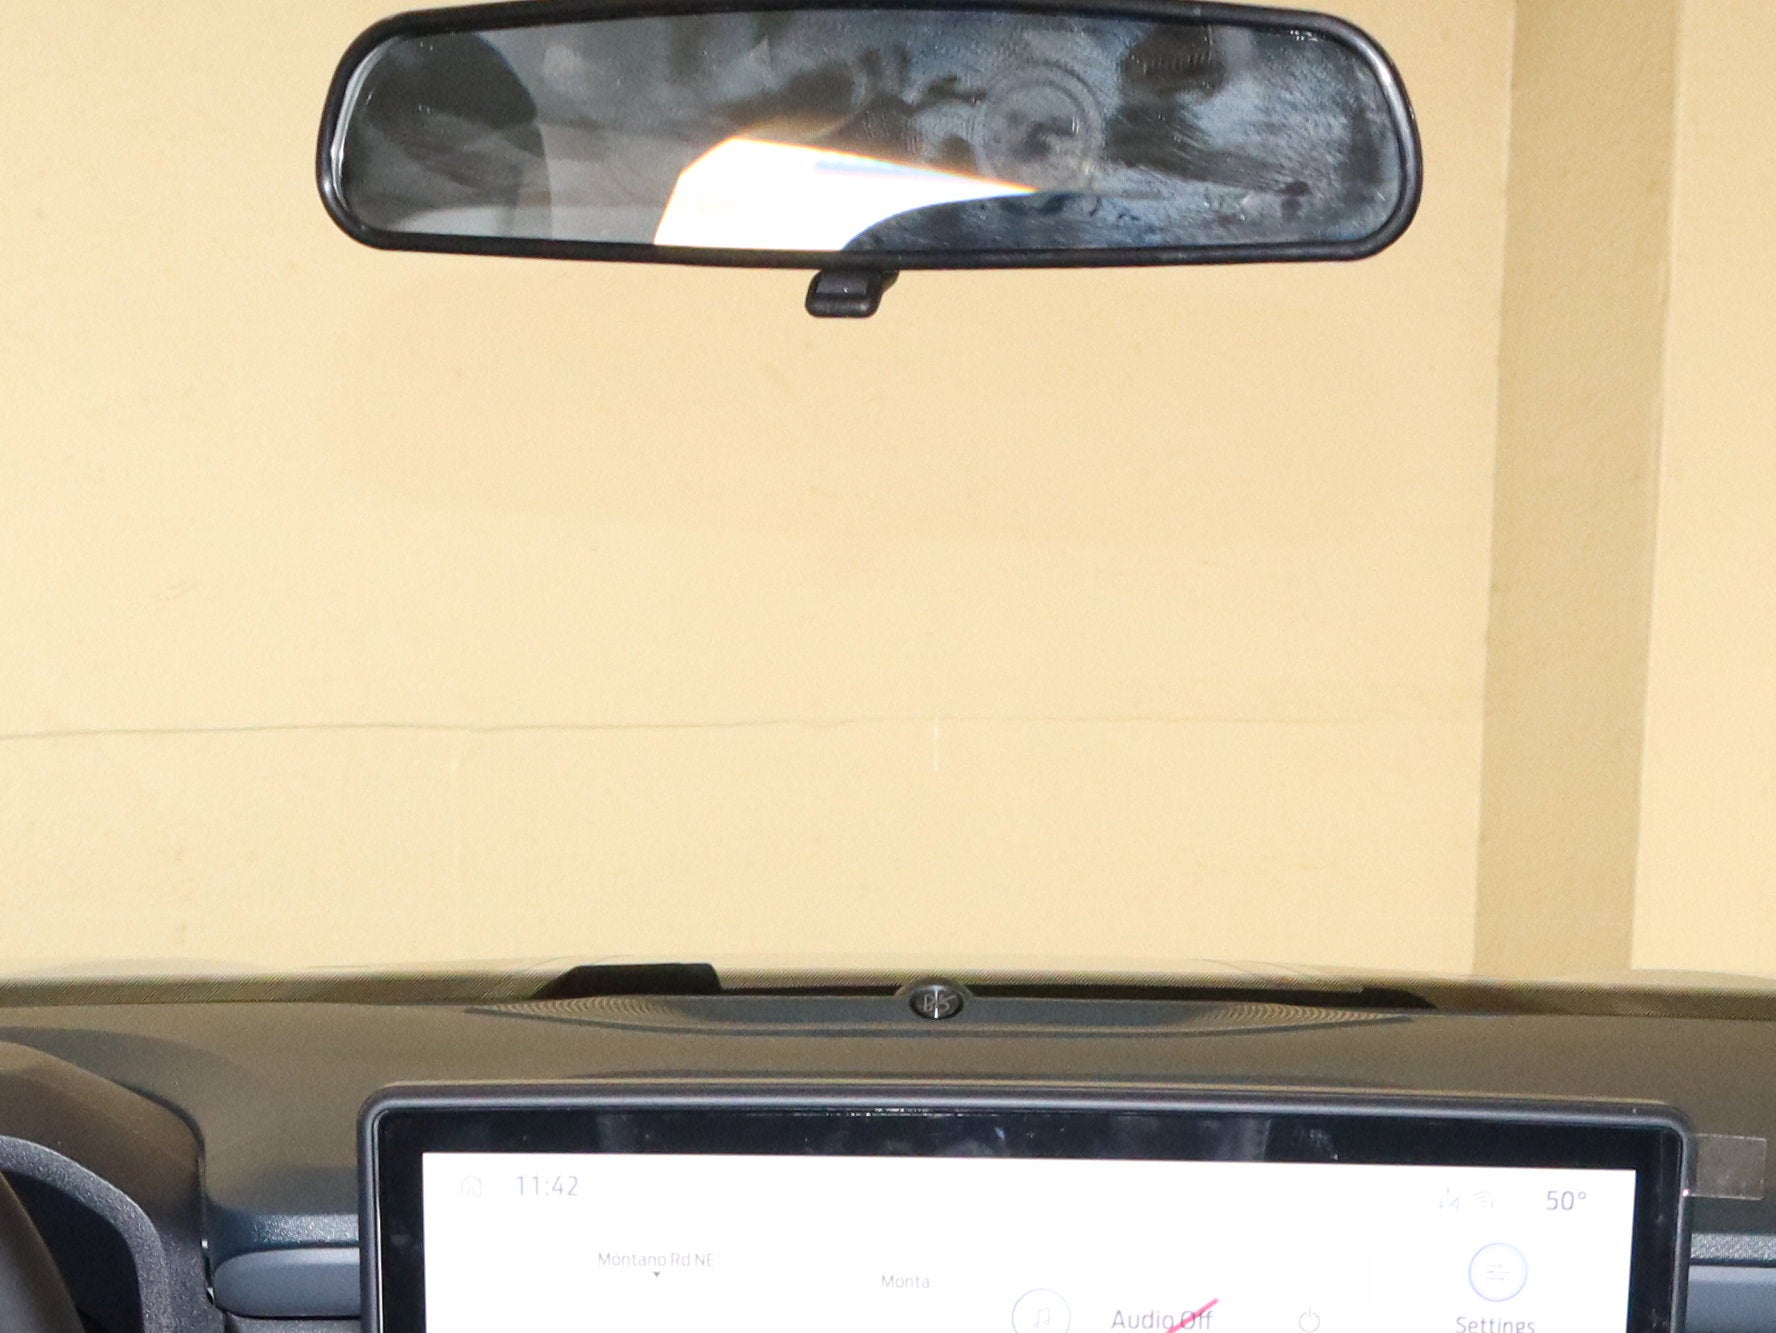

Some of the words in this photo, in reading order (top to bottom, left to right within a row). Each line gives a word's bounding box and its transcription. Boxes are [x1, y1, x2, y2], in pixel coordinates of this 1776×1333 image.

[514, 1174, 580, 1199] 11:42
[1544, 1188, 1588, 1213] 50°
[596, 1250, 666, 1270] Montano
[669, 1250, 691, 1269] Rd
[694, 1250, 714, 1269] NE
[1110, 1308, 1175, 1331] Audio
[1178, 1308, 1214, 1331] Off
